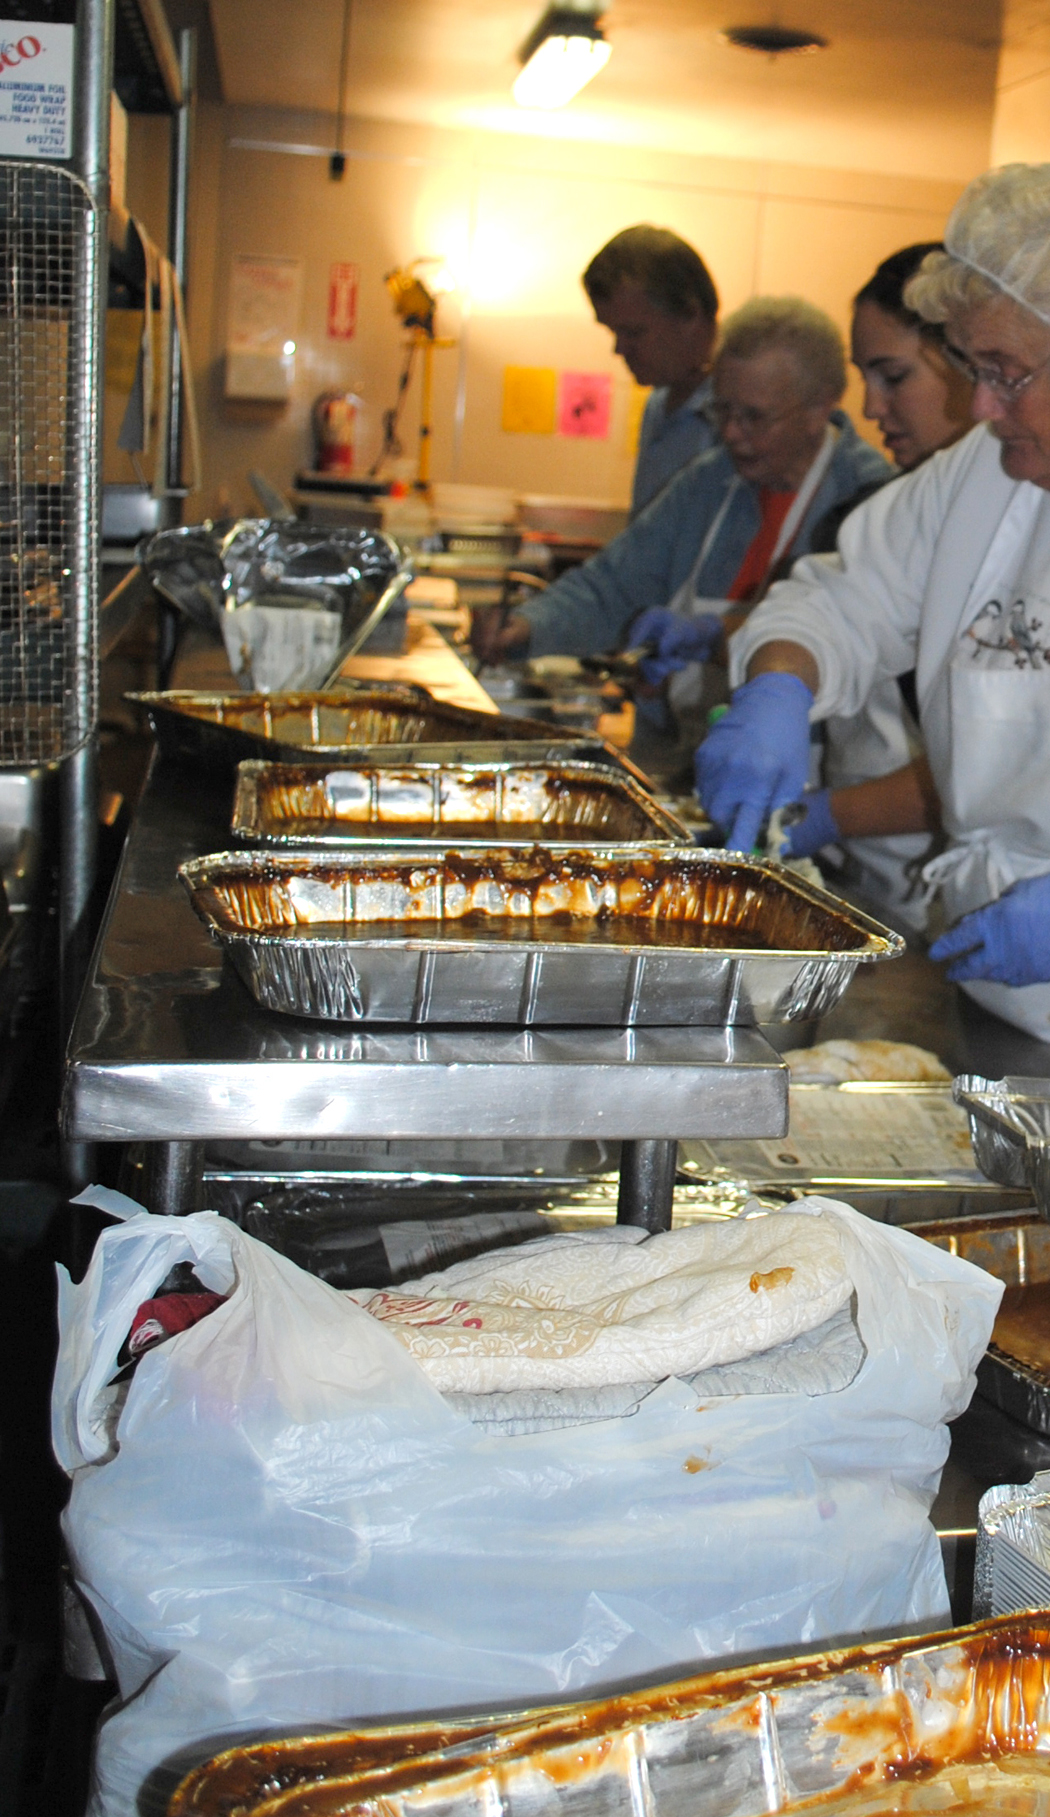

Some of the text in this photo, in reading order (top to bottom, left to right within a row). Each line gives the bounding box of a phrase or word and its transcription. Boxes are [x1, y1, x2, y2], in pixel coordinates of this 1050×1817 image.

[48, 84, 65, 94] FOIL
[13, 92, 66, 105] FOOD WRAP
[12, 103, 66, 116] HEAVY DUTY
